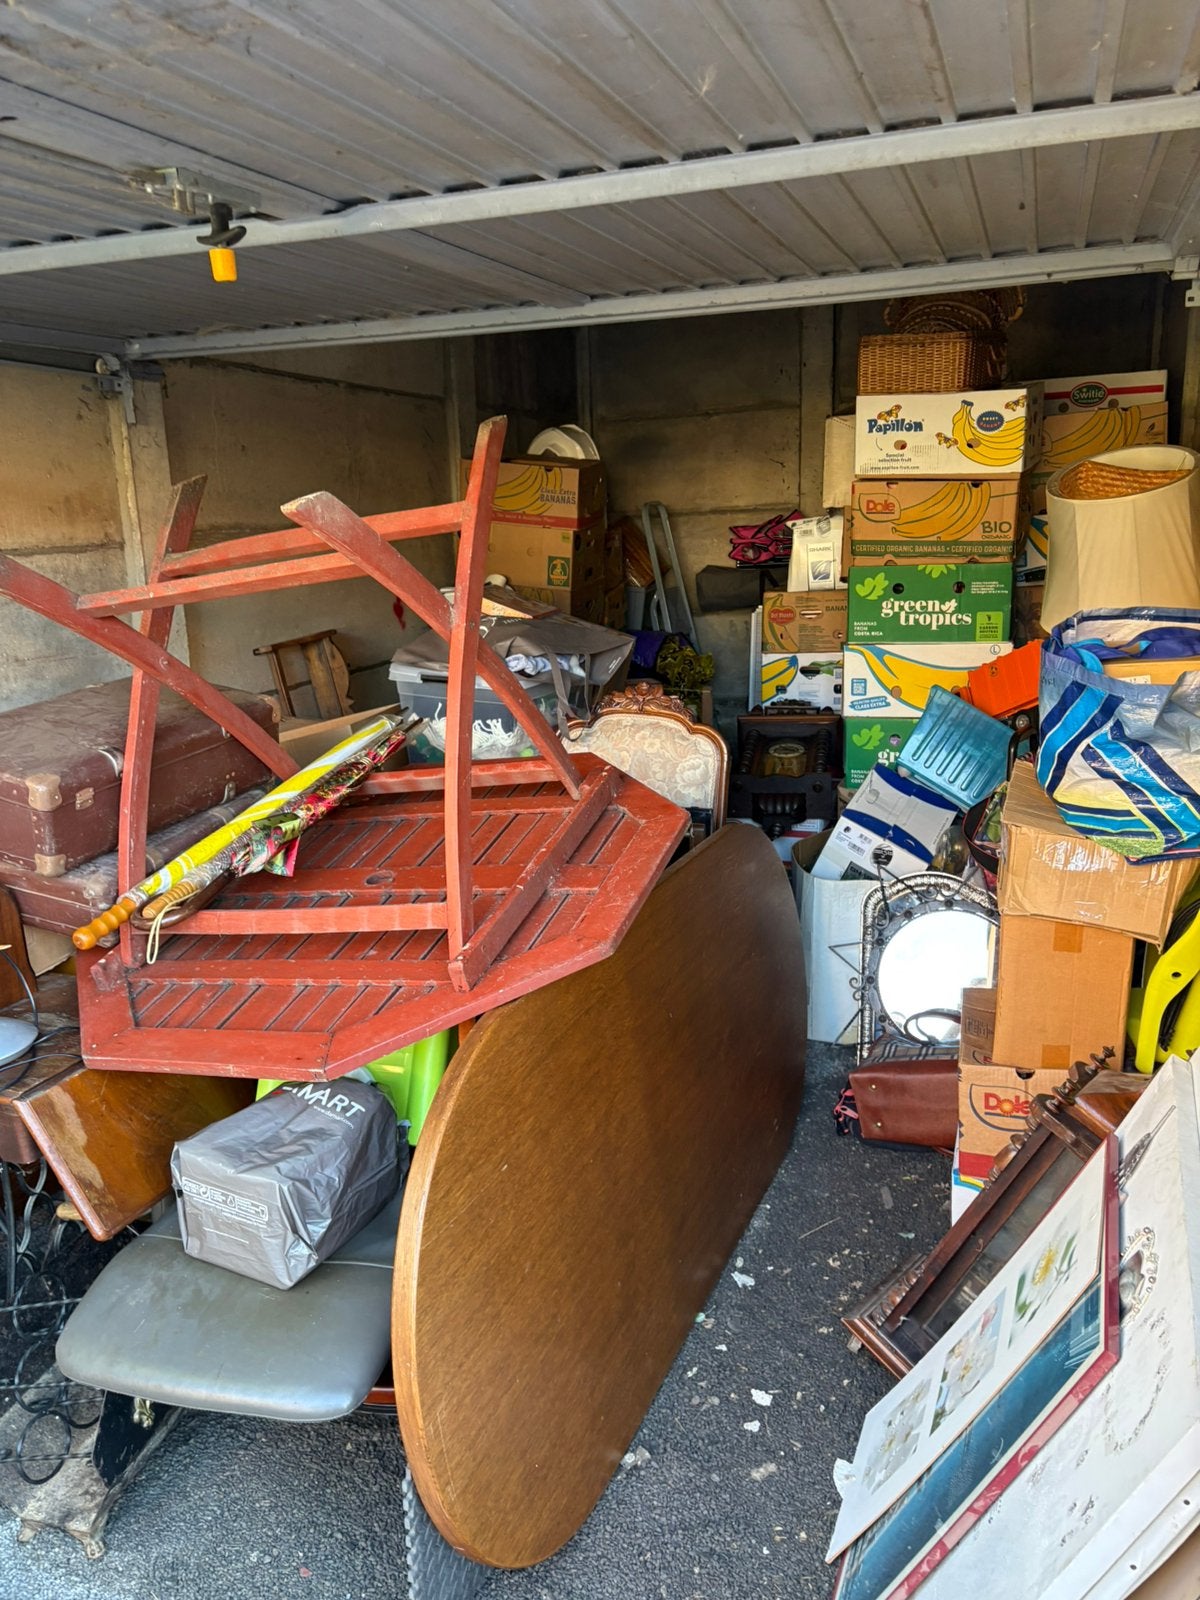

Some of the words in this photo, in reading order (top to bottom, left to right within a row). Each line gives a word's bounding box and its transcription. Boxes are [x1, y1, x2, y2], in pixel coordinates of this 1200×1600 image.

[867, 418, 922, 435] Papillon
[540, 493, 577, 505] BANANAS
[559, 488, 576, 497] Extra
[866, 499, 895, 512] Dole
[981, 521, 1012, 534] BIO
[886, 545, 914, 553] ORGANIC
[915, 545, 946, 553] BANANAS
[952, 545, 983, 553] CERTIFIED
[983, 545, 1013, 553] ORGANIC
[880, 598, 941, 618] green
[899, 612, 972, 630] tropics
[984, 1092, 1030, 1115] Dole
